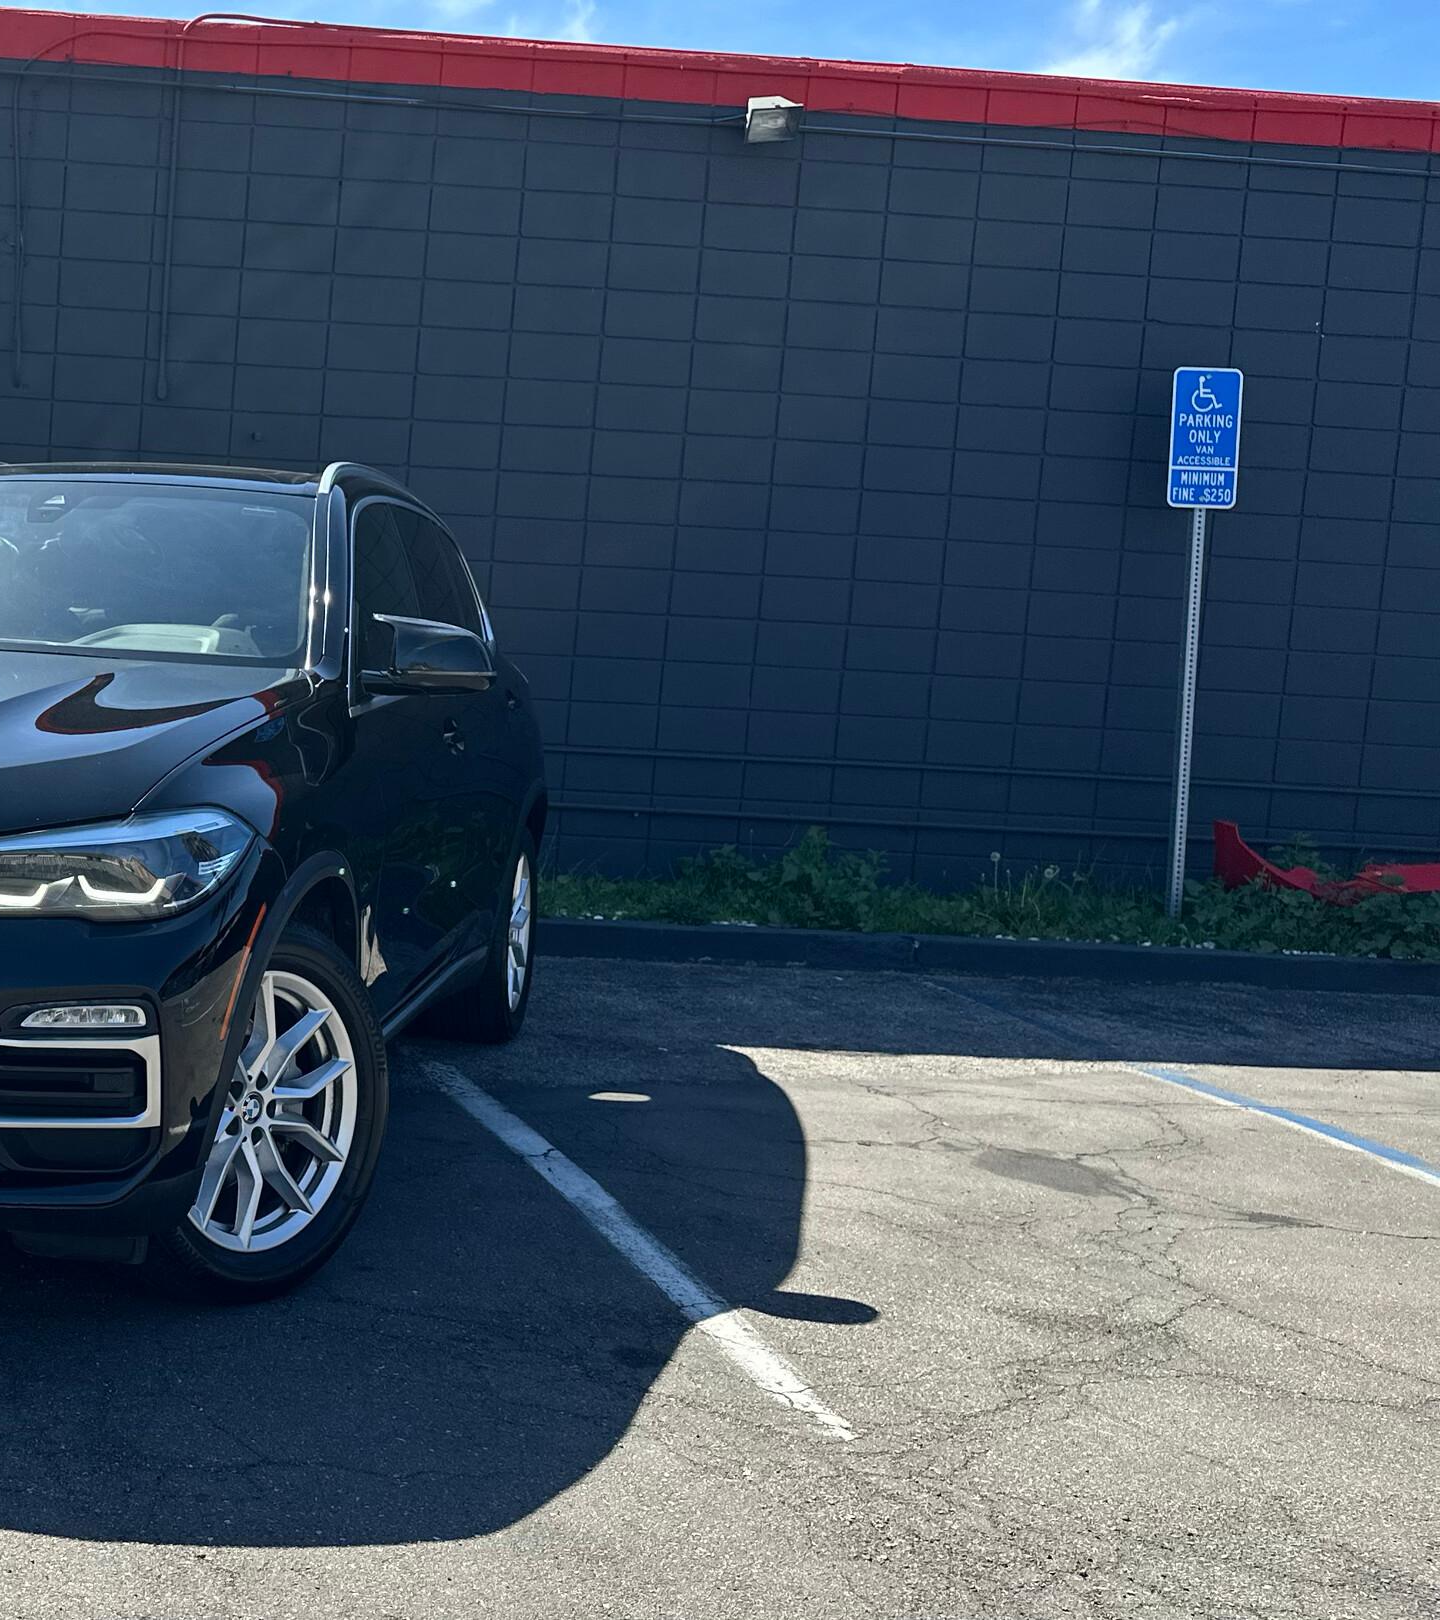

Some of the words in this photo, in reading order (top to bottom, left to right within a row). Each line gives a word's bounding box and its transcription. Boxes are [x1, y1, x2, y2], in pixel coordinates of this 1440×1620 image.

[1179, 413, 1233, 428] PARKING
[1189, 429, 1221, 444] ONLY
[1195, 445, 1214, 455] VAN
[1177, 456, 1231, 466] ACCESSIBLE
[1180, 471, 1225, 486] MINIMUM
[1172, 487, 1195, 501] FINE
[1203, 488, 1231, 503] $250
